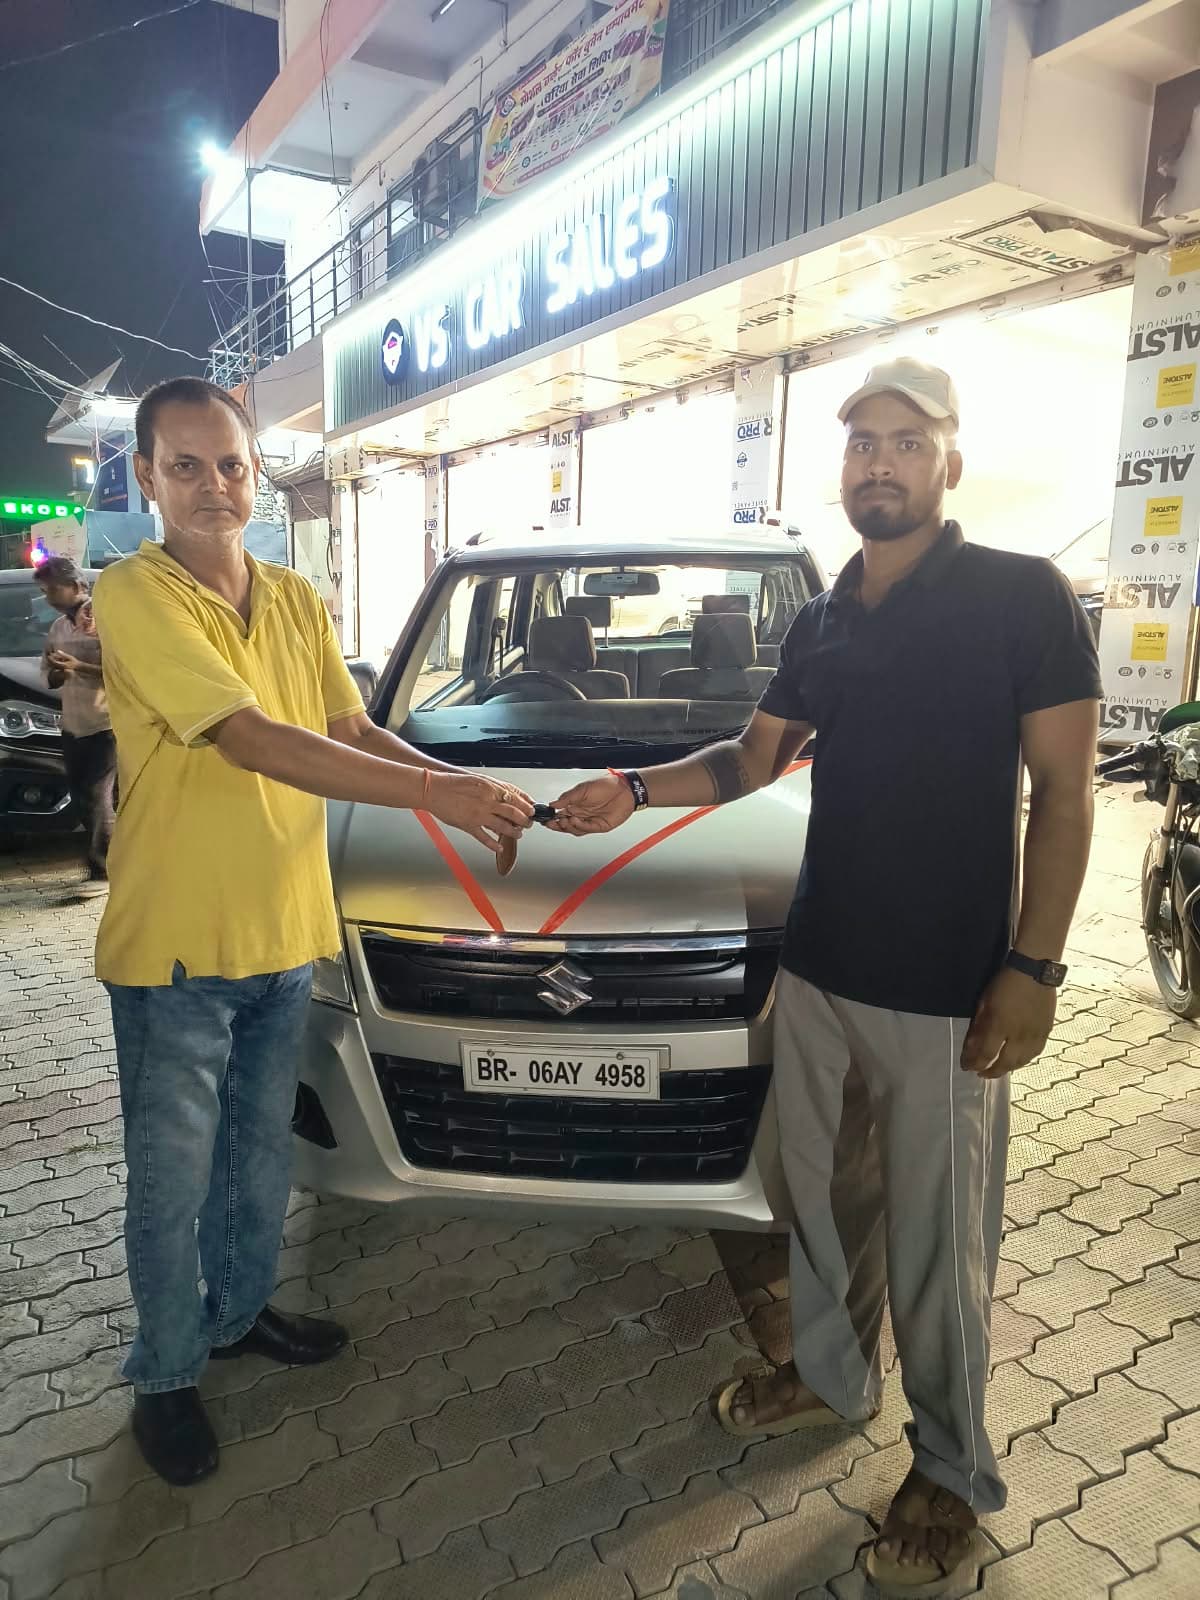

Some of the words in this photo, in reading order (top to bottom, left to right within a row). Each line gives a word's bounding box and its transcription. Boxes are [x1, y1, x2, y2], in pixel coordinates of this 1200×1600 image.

[413, 304, 452, 372] VS
[464, 263, 526, 350] CAR
[546, 176, 676, 314] SALES
[737, 422, 760, 440] PRO
[1124, 443, 1195, 460] ALUMINIUM
[1115, 453, 1195, 487] ALST
[550, 497, 571, 514] ALST
[734, 509, 756, 524] PRO
[477, 1057, 516, 1082] BR-
[529, 1060, 583, 1085] 06AY
[595, 1063, 646, 1088] 4958
